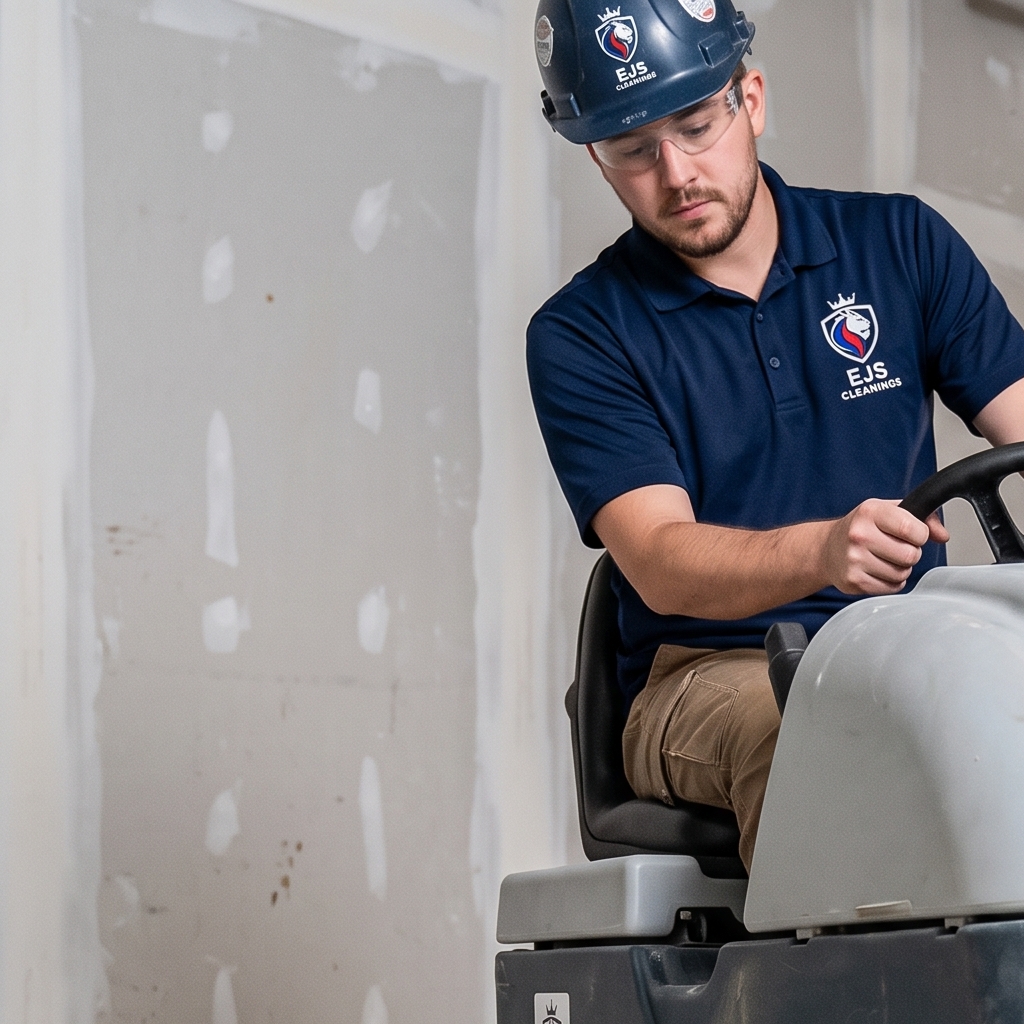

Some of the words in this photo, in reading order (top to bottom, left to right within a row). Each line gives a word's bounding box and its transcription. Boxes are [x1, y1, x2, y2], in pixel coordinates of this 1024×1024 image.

[615, 61, 648, 82] EJS
[846, 361, 888, 387] EJS
[841, 377, 902, 400] CLEANINGS
